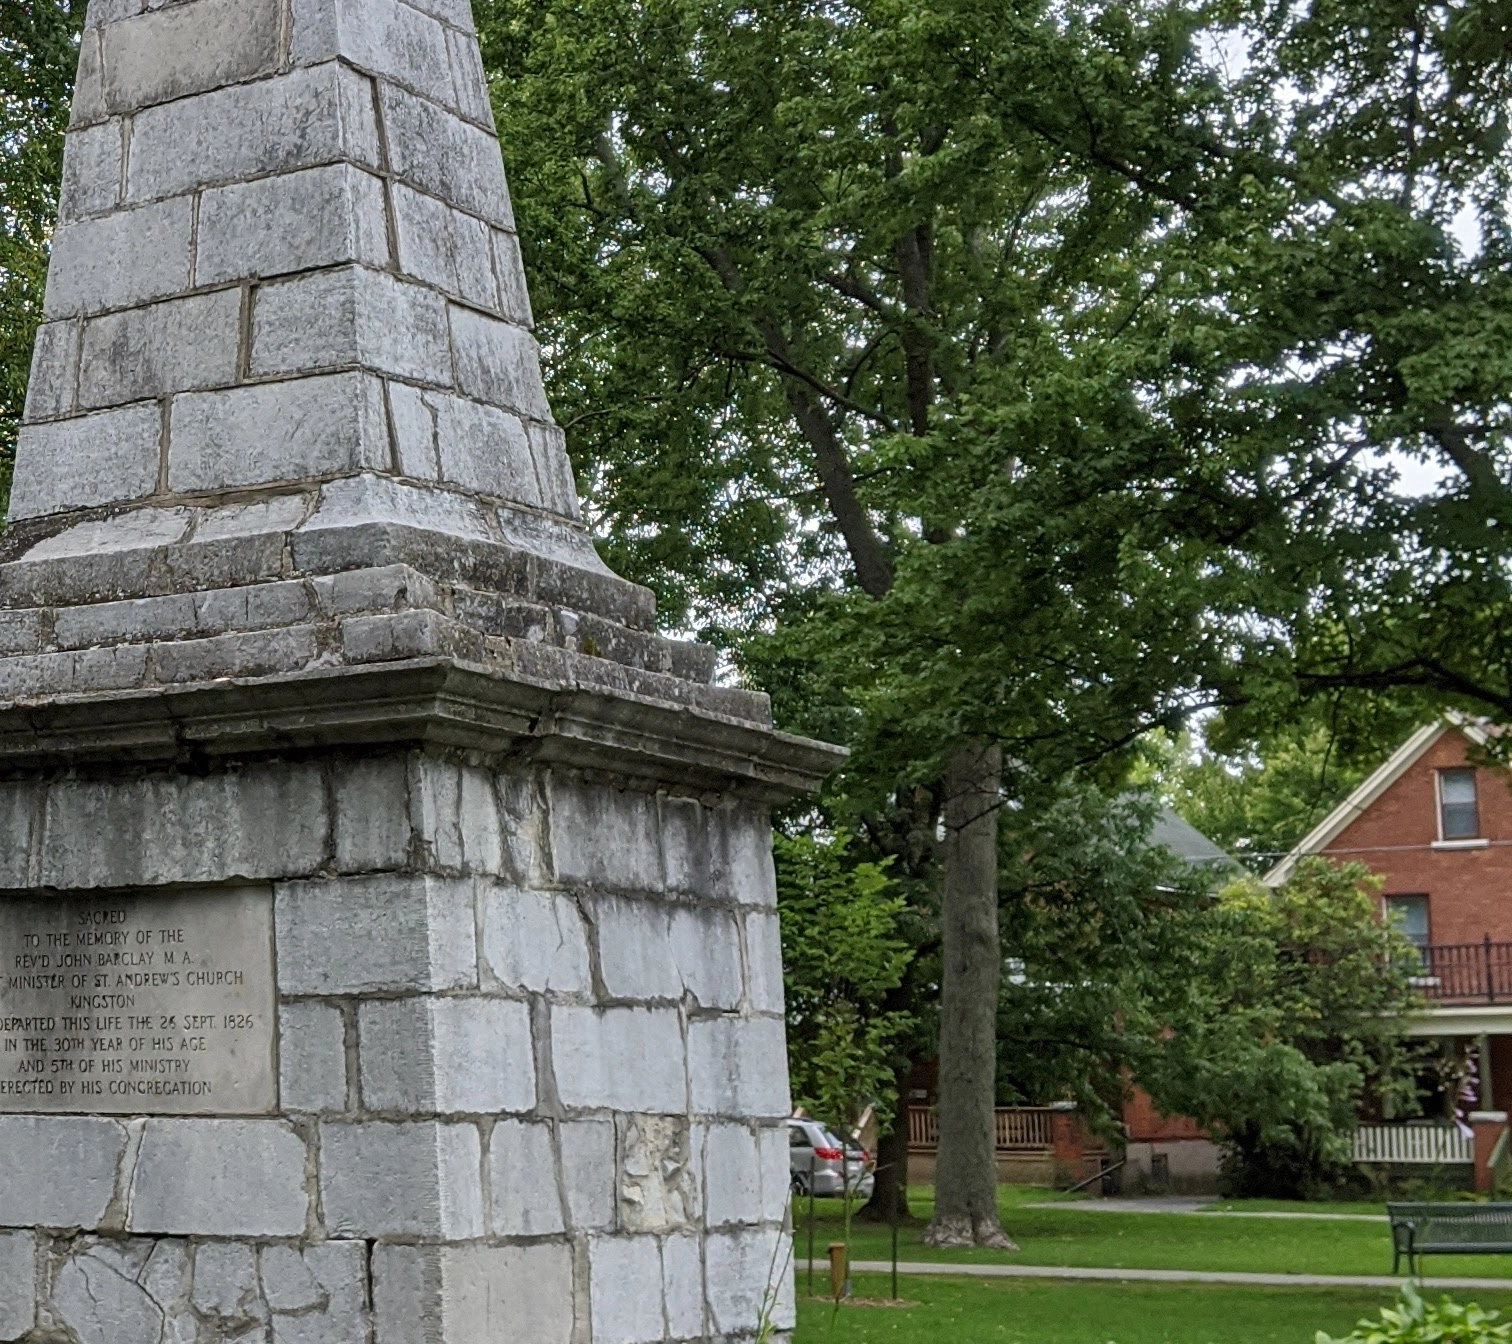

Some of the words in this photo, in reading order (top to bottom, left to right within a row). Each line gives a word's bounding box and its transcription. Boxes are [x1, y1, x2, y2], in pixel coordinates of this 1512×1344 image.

[78, 910, 126, 925] SACRED
[24, 934, 40, 947] TO
[46, 933, 70, 947] THE
[76, 930, 129, 946] MEMORY
[136, 930, 153, 944] OF
[159, 929, 184, 943] THE
[15, 955, 50, 968] REV'D
[56, 953, 92, 968] JOHN
[98, 952, 154, 966] BARCLAY
[182, 951, 194, 964] A.
[9, 974, 65, 989] MINISTER
[71, 974, 87, 987] OF
[94, 974, 111, 987] ST.
[116, 972, 180, 987] ANDREW'S
[187, 971, 243, 986] CHURCH
[71, 994, 135, 1008] KINGSTON
[62, 1017, 89, 1030] THIS
[96, 1016, 122, 1030] LIFE
[128, 1016, 153, 1029] THE
[223, 1014, 254, 1029] 1826
[5, 1038, 17, 1051] IN
[23, 1038, 47, 1051] THE
[54, 1038, 85, 1051] 30TH
[91, 1037, 123, 1051] YEAR
[129, 1038, 146, 1051] OF
[152, 1037, 174, 1051] HIS
[180, 1037, 207, 1051] AGE
[18, 1060, 44, 1073] AND
[51, 1059, 73, 1073] 5TH
[79, 1059, 95, 1072] OF
[102, 1059, 123, 1073] HIS
[130, 1059, 190, 1073] MINISTRY
[0, 1080, 54, 1094] ERECTED
[60, 1081, 75, 1094] BY
[81, 1080, 103, 1094] HIS
[109, 1080, 212, 1095] CONGREGATION
